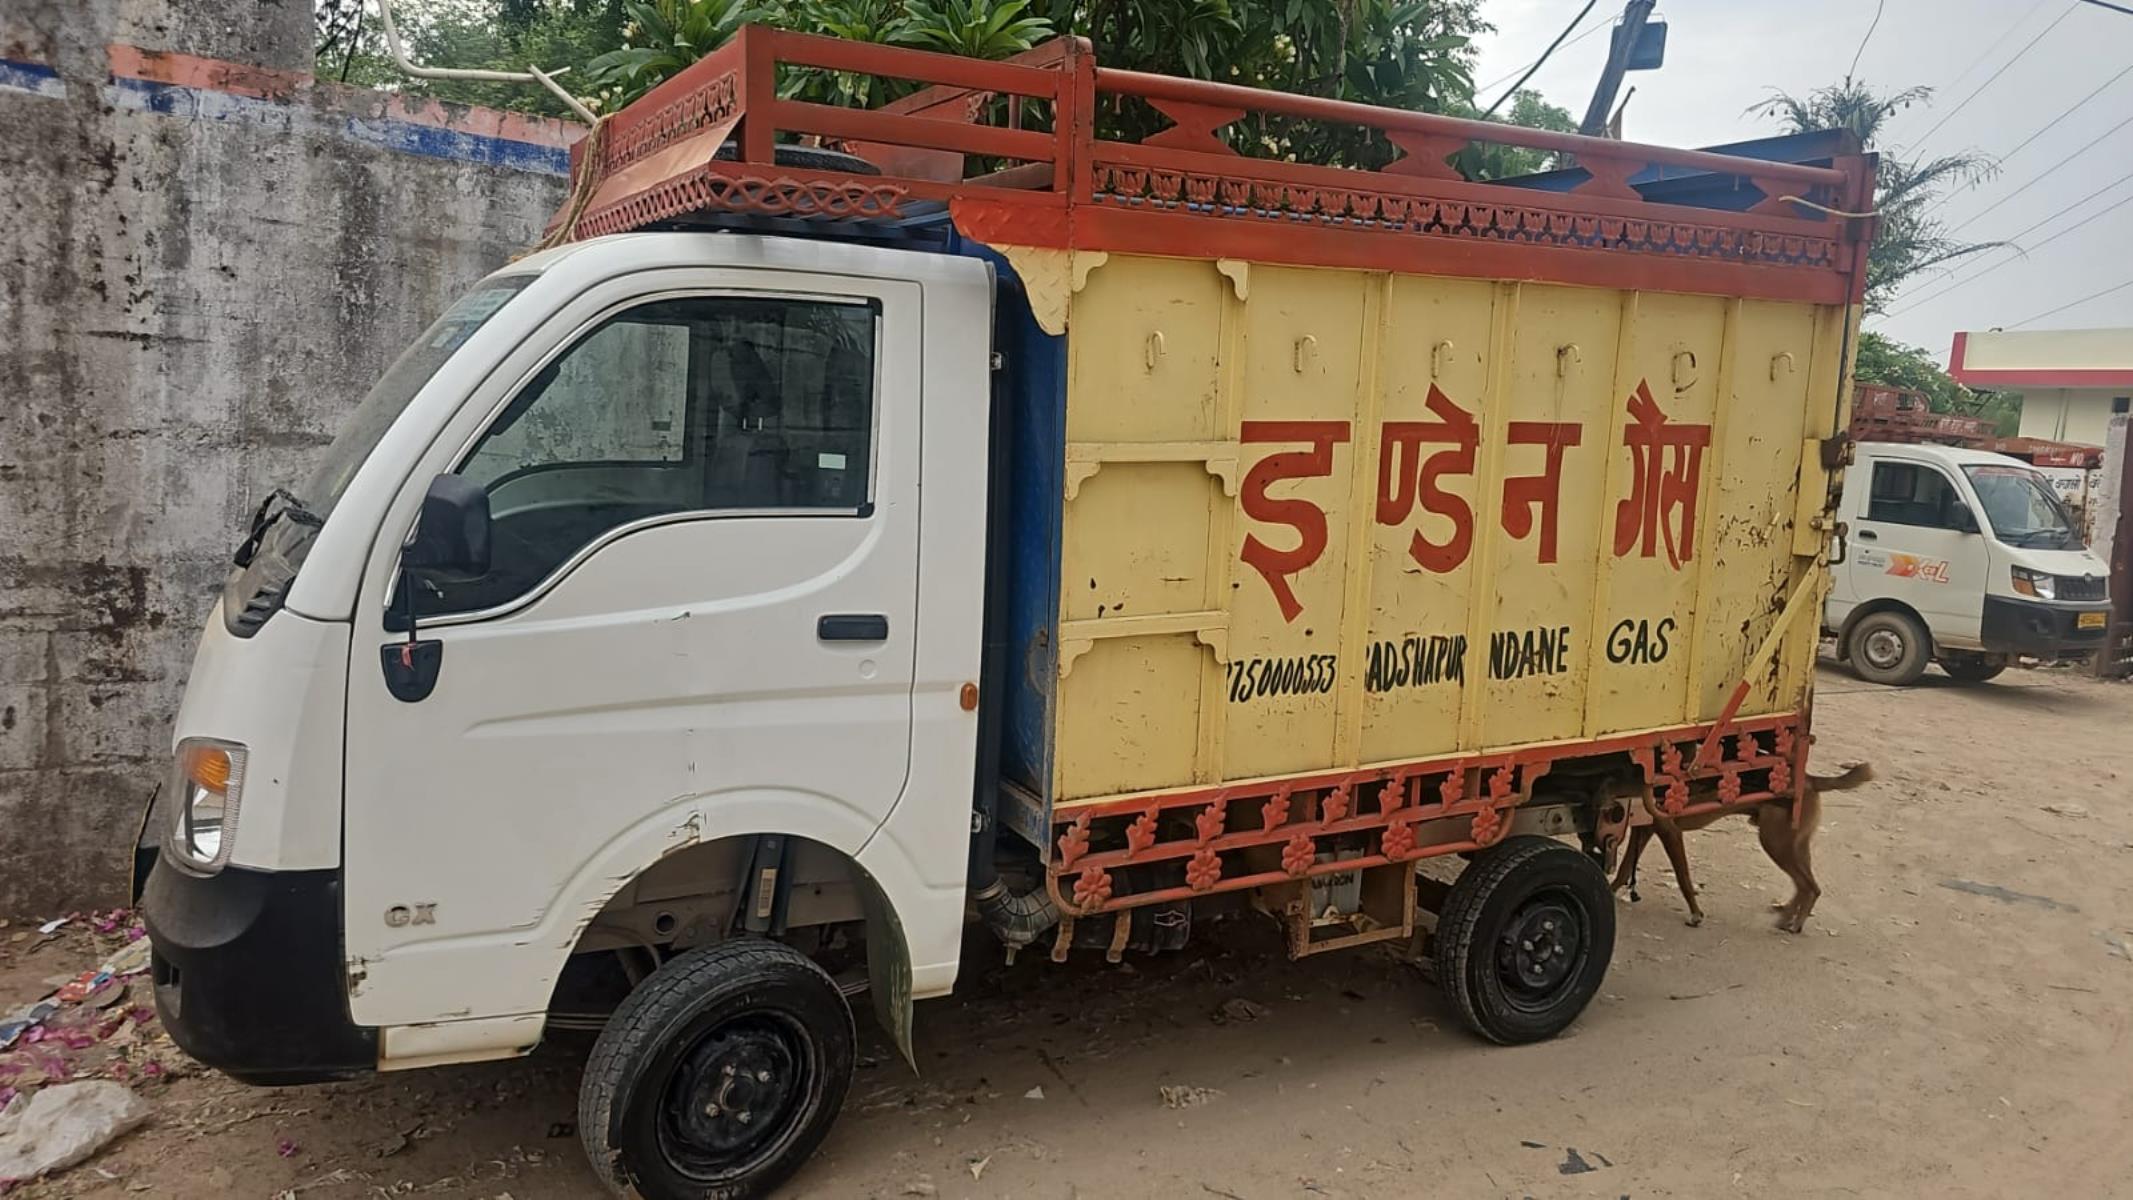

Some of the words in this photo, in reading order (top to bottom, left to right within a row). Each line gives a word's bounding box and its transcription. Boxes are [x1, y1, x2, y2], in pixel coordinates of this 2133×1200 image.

[1613, 377, 1711, 571] गैस
[1365, 634, 1467, 692] ADSHAPUR
[1606, 617, 1675, 664] GAS
